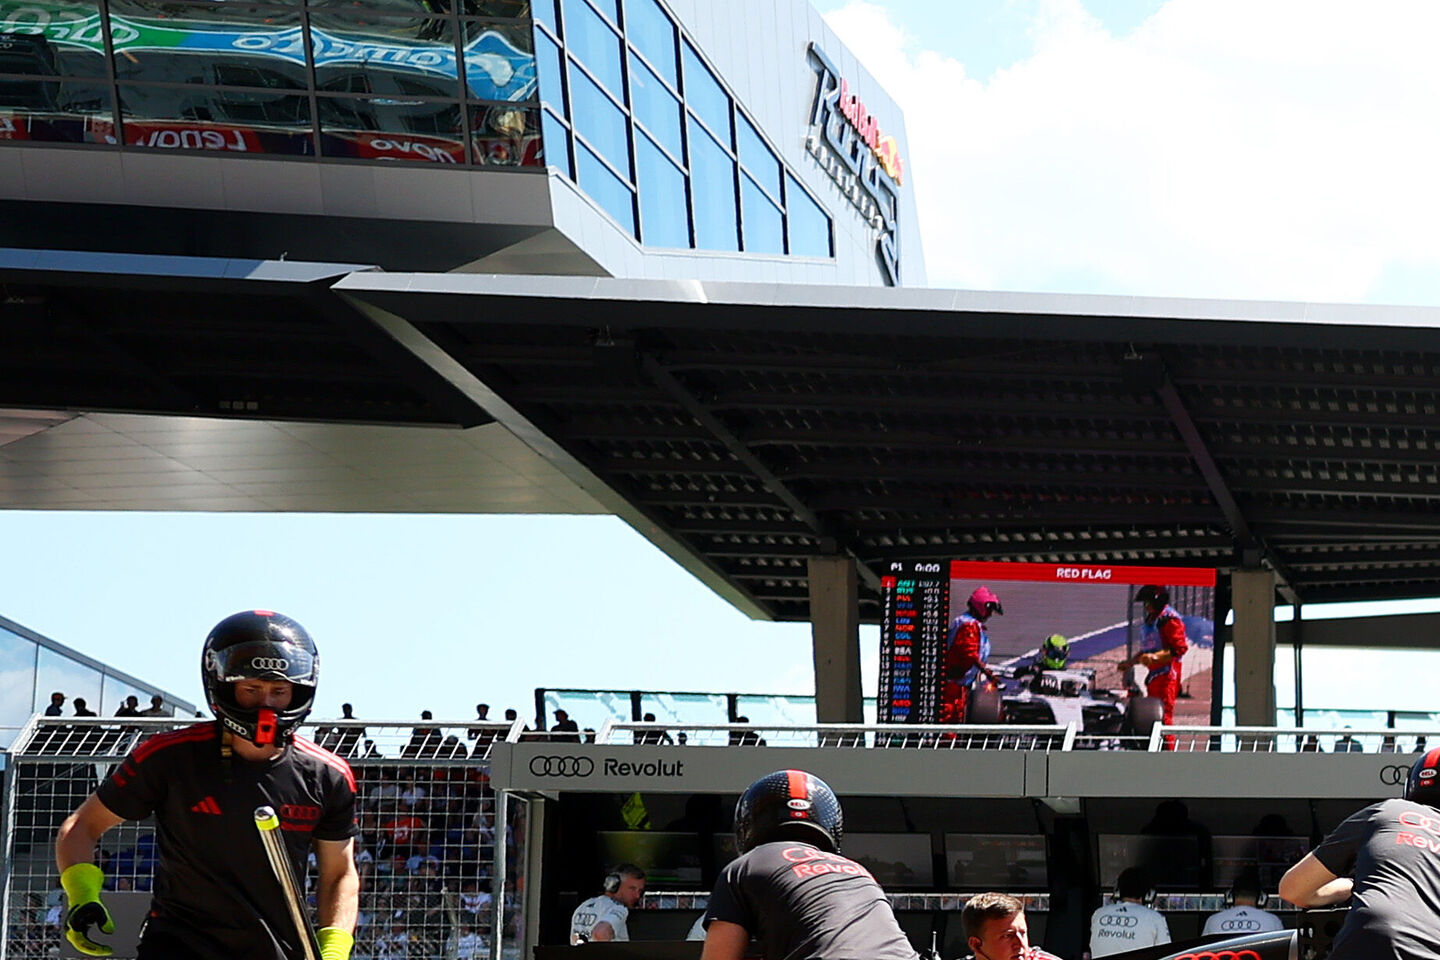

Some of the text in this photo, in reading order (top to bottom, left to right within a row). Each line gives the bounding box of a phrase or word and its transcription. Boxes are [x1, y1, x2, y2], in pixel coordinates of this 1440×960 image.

[1056, 567, 1112, 580] RED FLAG
[604, 758, 684, 777] Revolut
[1097, 928, 1136, 941] Revolut
